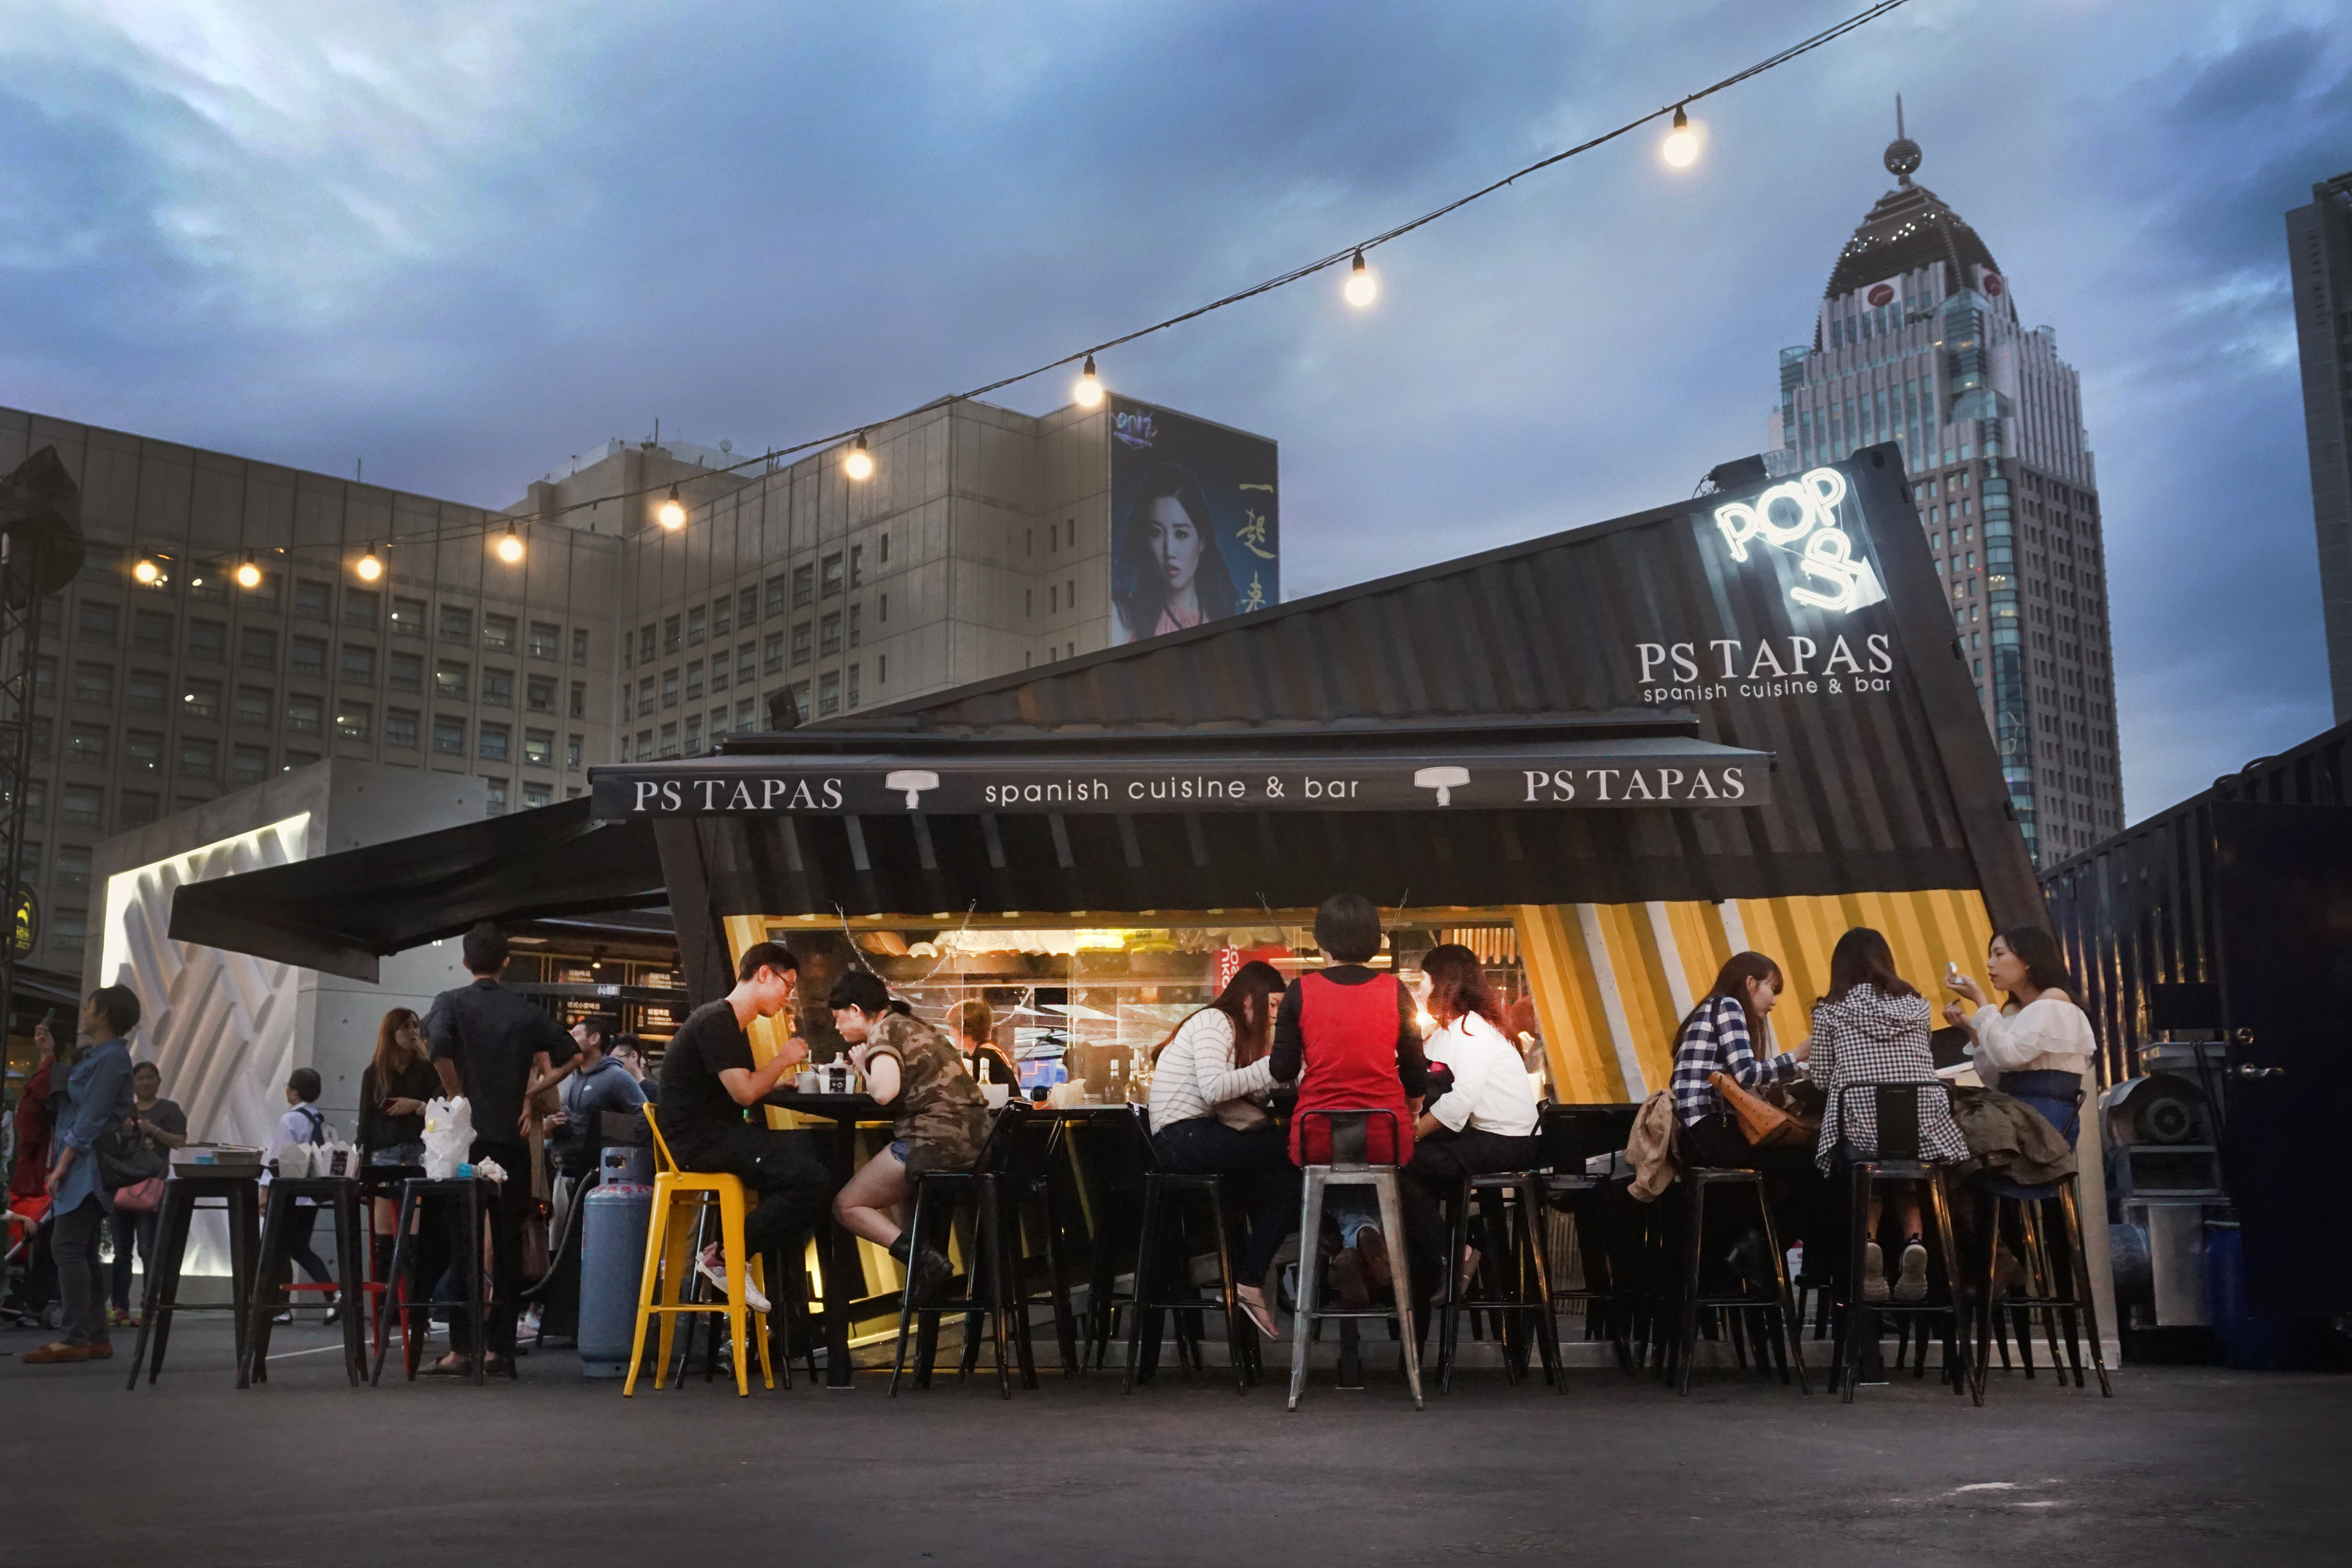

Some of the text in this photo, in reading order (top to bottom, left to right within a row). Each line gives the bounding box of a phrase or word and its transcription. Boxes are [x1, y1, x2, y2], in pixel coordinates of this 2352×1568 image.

[1714, 467, 1847, 562] POP
[1635, 633, 1893, 684] PS TAPAS
[1644, 676, 1891, 703] spanish cuisine & bar
[633, 778, 843, 810] PS TAPAS
[985, 778, 1108, 807] spanish
[1266, 775, 1285, 798] &
[1305, 776, 1359, 798] bar
[1523, 767, 1745, 802] PS TAPAS
